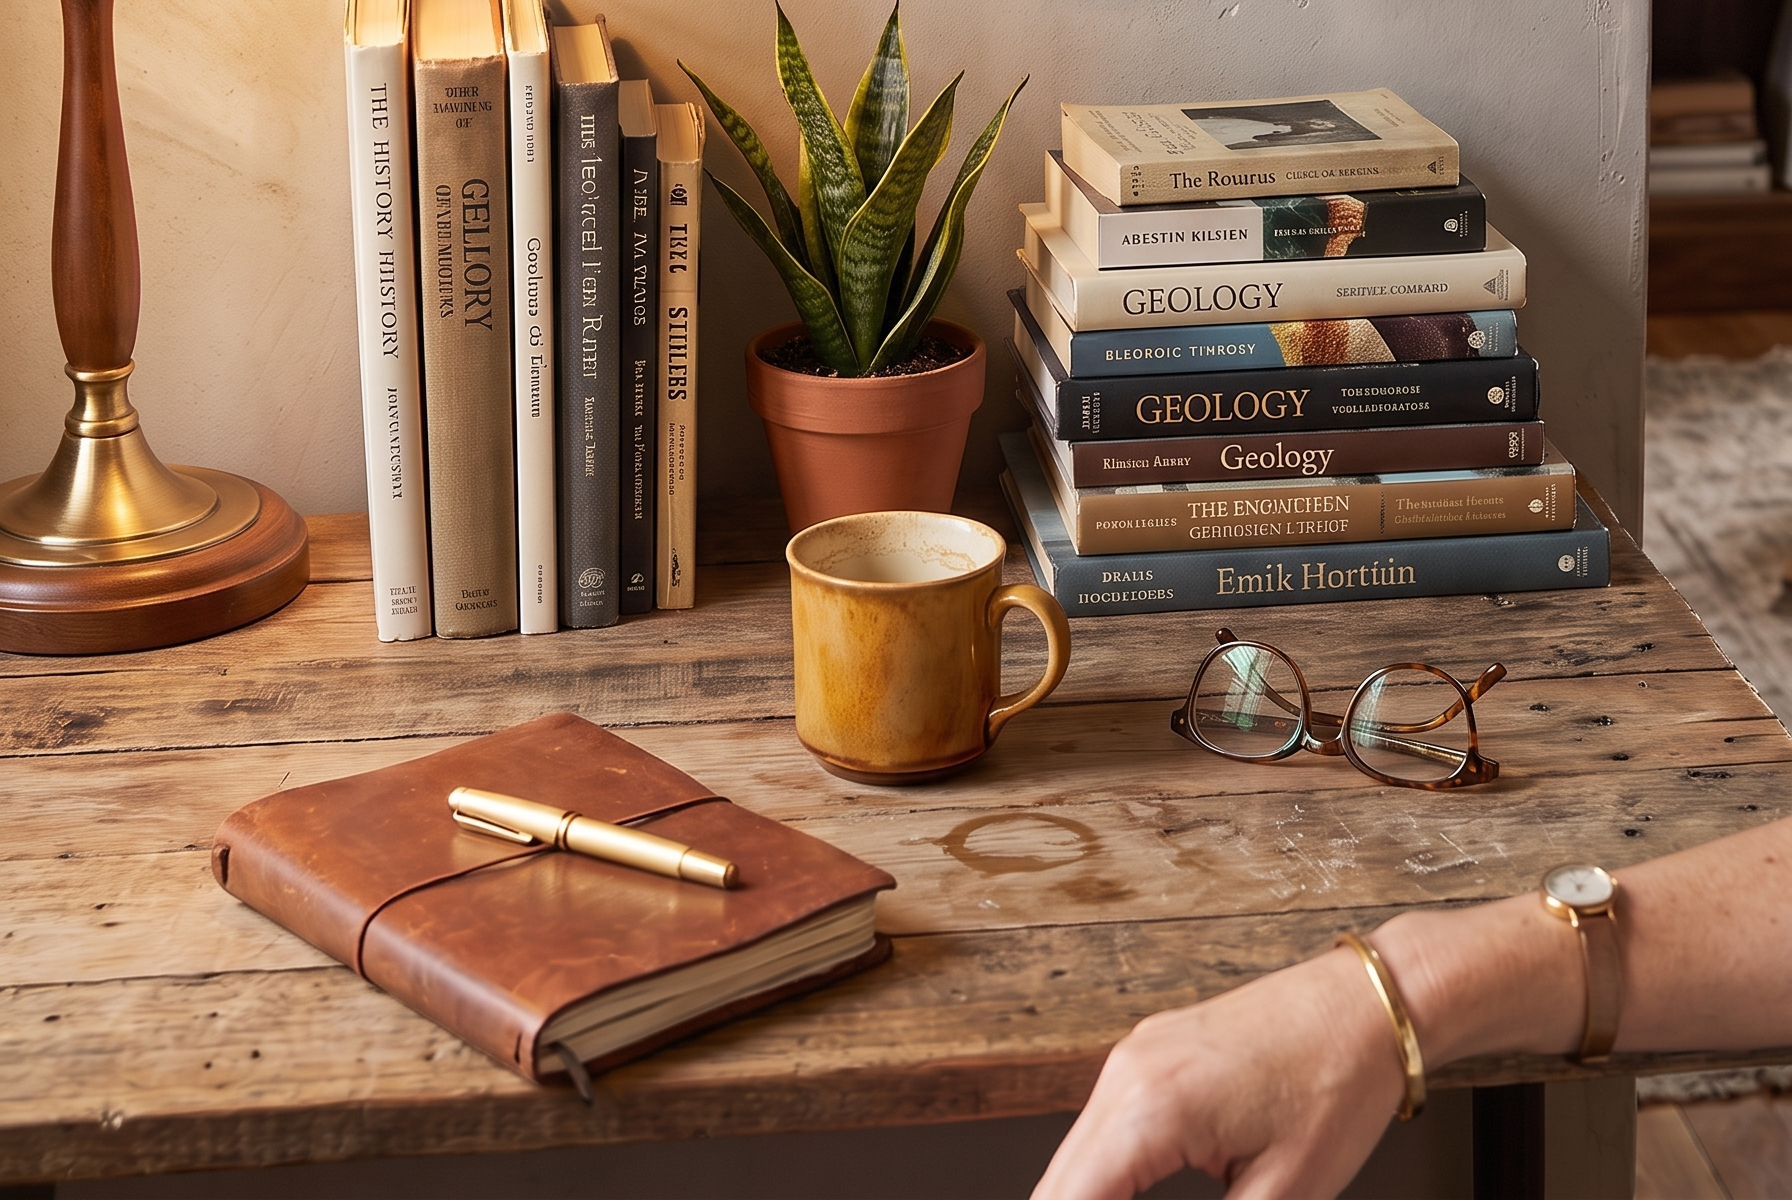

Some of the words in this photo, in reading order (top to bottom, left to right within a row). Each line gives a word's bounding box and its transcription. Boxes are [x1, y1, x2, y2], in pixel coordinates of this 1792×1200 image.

[371, 83, 389, 129] THE
[374, 140, 394, 239] HISTORY
[1169, 172, 1202, 189] The
[1122, 231, 1185, 245] ABESTIN
[1192, 229, 1248, 242] KILSIEN
[462, 179, 493, 331] GELLORY
[1123, 282, 1283, 315] GEOLOGY
[1105, 347, 1181, 361] BLEOROIC
[1136, 389, 1310, 424] GEOLOGY
[1220, 442, 1334, 475] Geology
[1188, 501, 1229, 519] THE
[1216, 563, 1295, 596] Emik
